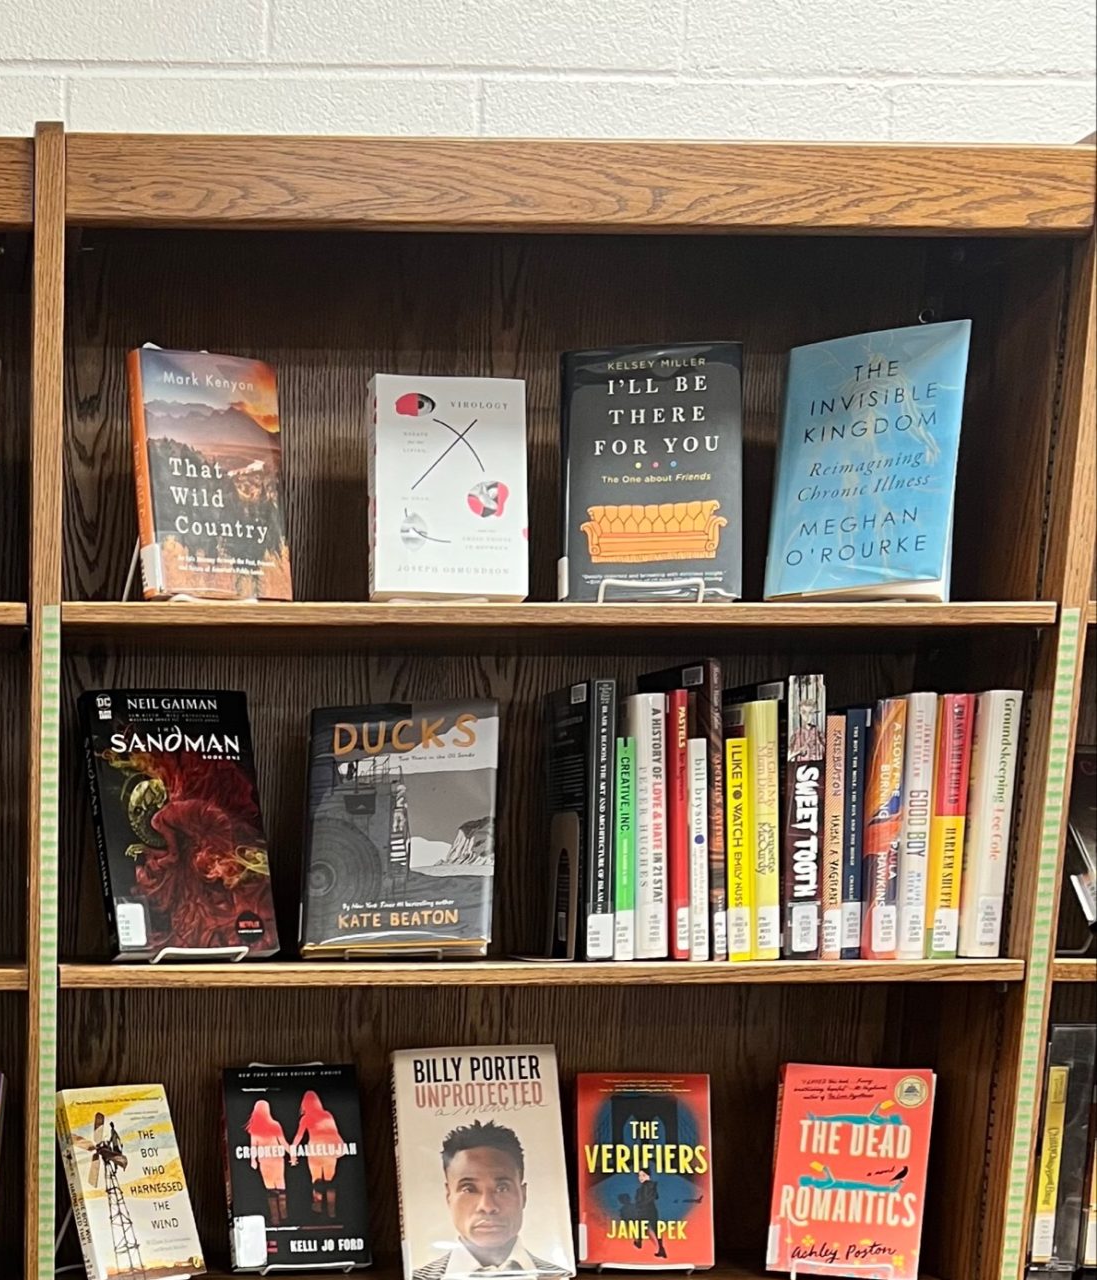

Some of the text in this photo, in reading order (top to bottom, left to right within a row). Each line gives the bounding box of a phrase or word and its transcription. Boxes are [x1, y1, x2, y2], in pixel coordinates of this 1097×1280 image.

[607, 357, 706, 371] KELSEY MILLER
[853, 360, 898, 382] THE
[163, 371, 254, 392] Mark Kenyon
[607, 375, 707, 395] I'LL BE
[451, 400, 508, 410] VIROLOGY
[809, 382, 937, 416] INVISIBLE
[609, 406, 705, 426] THERE
[804, 412, 937, 444] KINGDOM
[594, 435, 720, 456] FOR YOU
[169, 457, 223, 479] That
[809, 451, 924, 478] Reimagining
[602, 472, 711, 484] The One about Friends
[798, 472, 930, 503] Chronic Illness
[170, 486, 223, 509] Wild
[176, 517, 268, 542] Country
[800, 507, 917, 537] MEGHAN
[785, 535, 926, 567] O'ROURKE
[127, 699, 217, 710] NEIL GAIMAN
[111, 725, 240, 753] SANDMAN
[333, 714, 478, 756] DUCKS
[990, 697, 1016, 803] Groundskeeping
[793, 764, 819, 898] SWEET TOOTH
[337, 909, 459, 929] KATE BEATON
[414, 1055, 541, 1083] BILLY PORTER
[415, 1081, 543, 1108] UNPROTECTED
[137, 1130, 155, 1140] THE
[630, 1121, 659, 1140] THE
[799, 1120, 911, 1159] THE DEAD
[141, 1148, 159, 1158] BOY
[236, 1143, 357, 1159] CROOKED HALLELUJAH
[585, 1145, 708, 1174] VERIFIERS
[142, 1165, 165, 1176] WHO
[130, 1181, 184, 1195] HARNESSED
[153, 1202, 170, 1211] THE
[779, 1185, 917, 1227] ROMANTICS
[151, 1217, 179, 1230] WIND
[607, 1221, 686, 1240] JANE PEK
[290, 1239, 364, 1252] KELLI JO FORD
[791, 1242, 897, 1263] Ashley Poston
